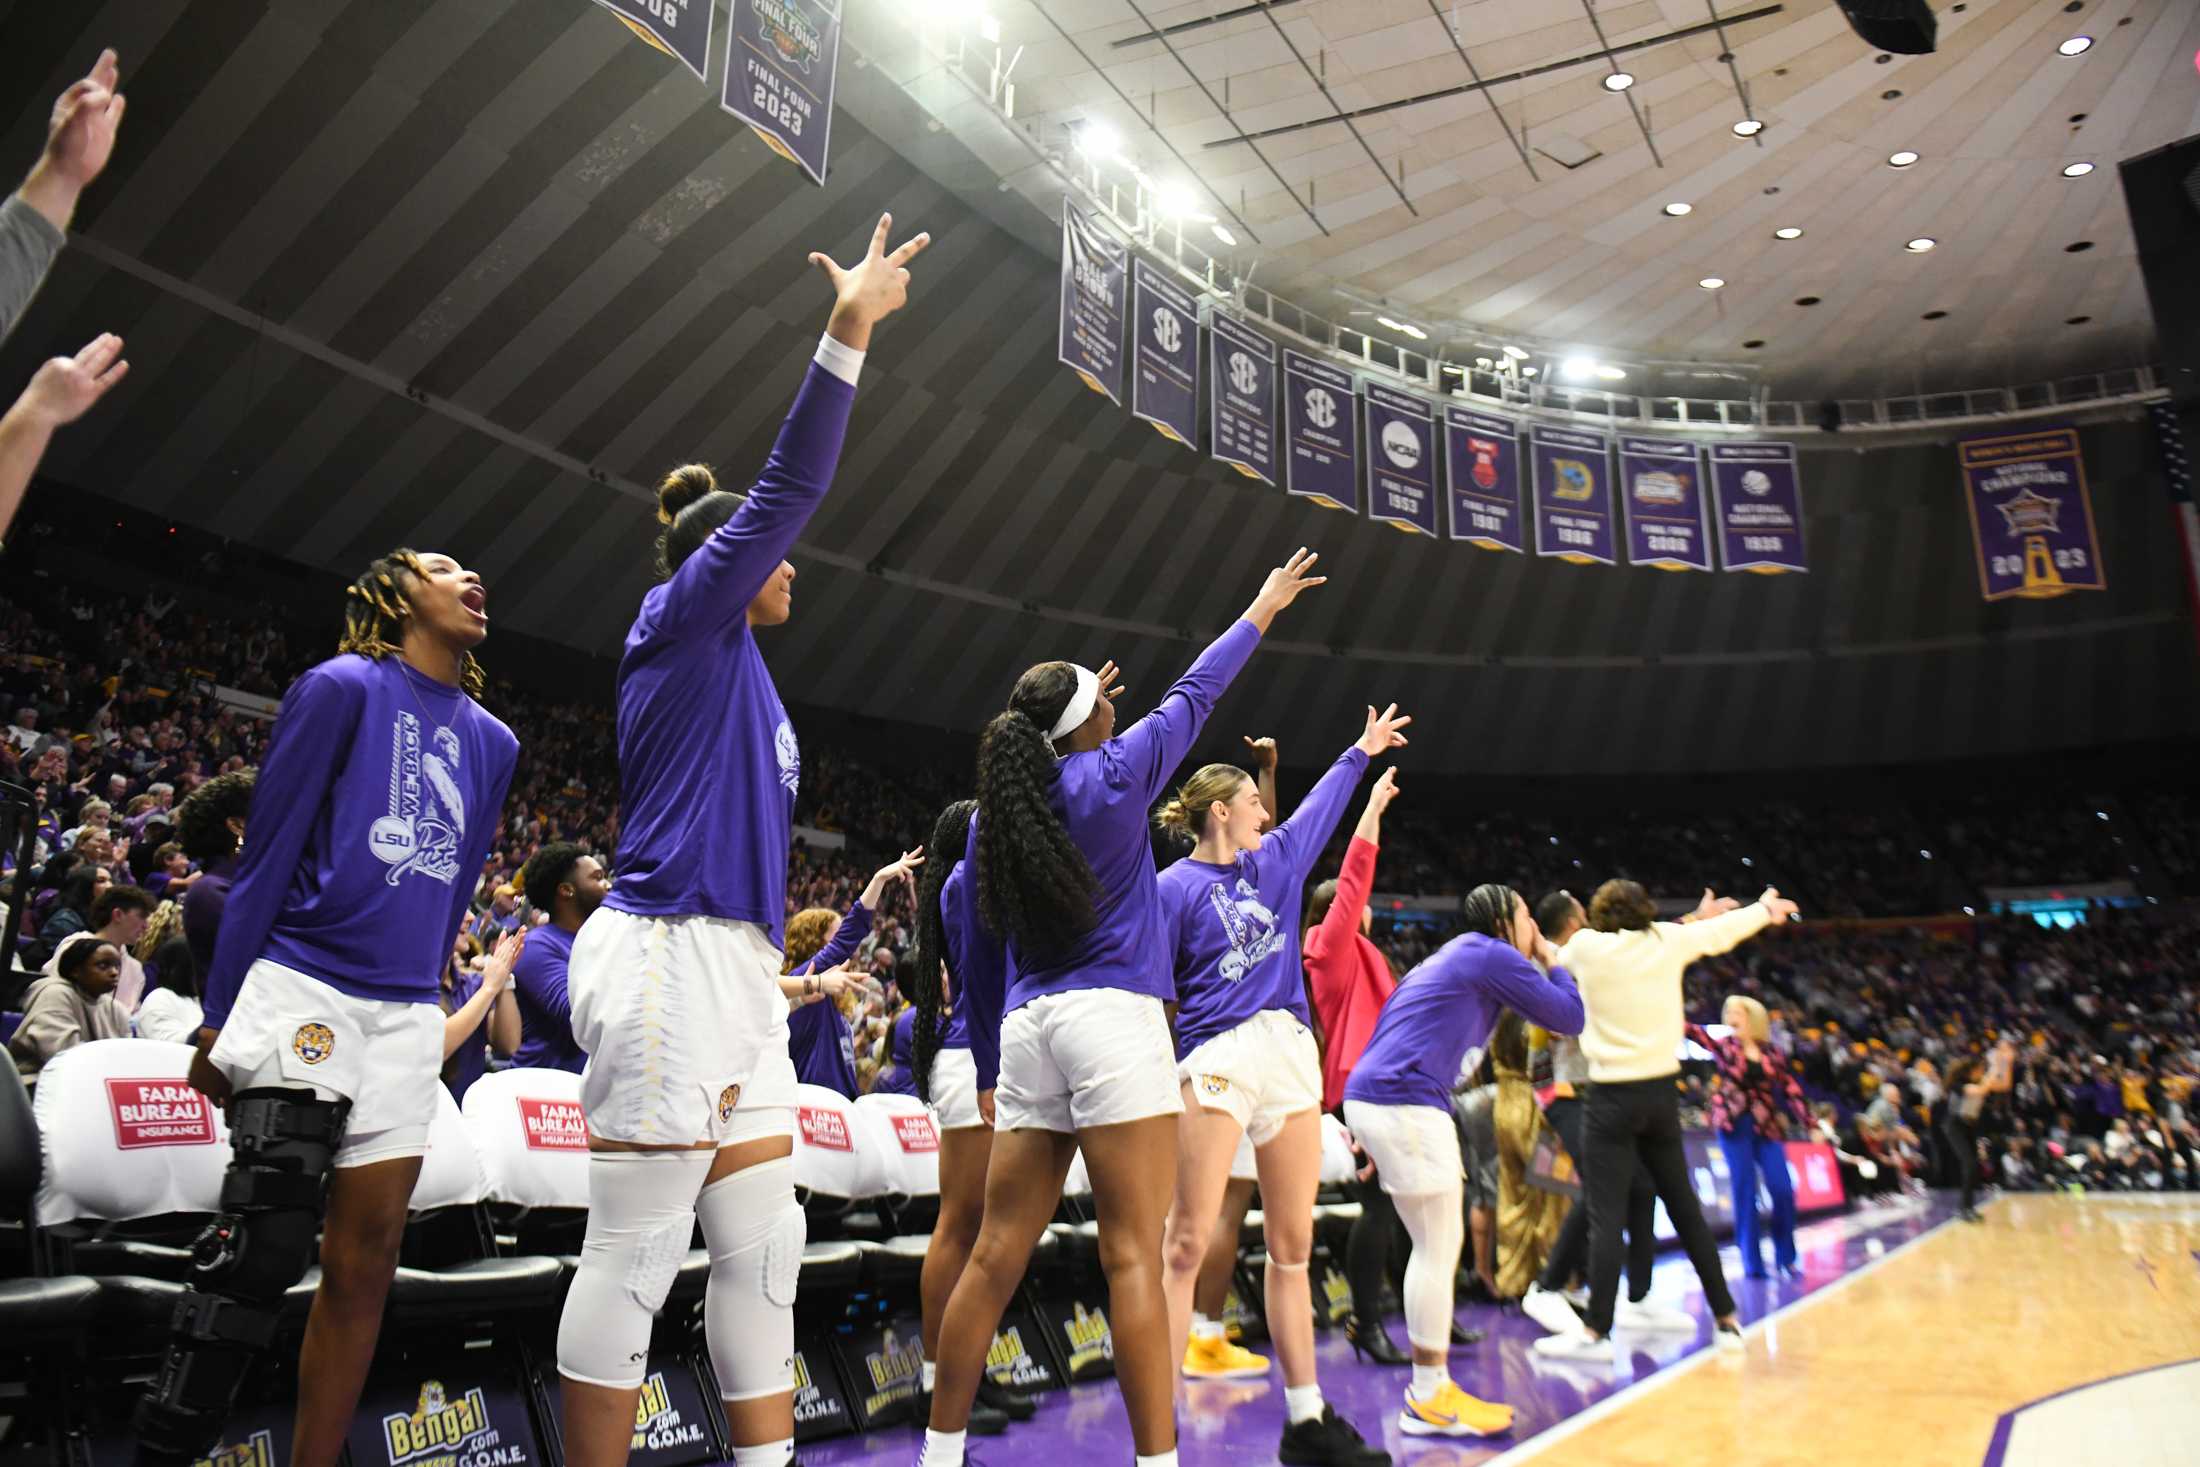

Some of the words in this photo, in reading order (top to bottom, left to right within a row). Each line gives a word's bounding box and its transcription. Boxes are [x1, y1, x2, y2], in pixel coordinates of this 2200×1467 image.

[789, 20, 819, 57] FOUR
[748, 59, 780, 94] FINAL
[784, 86, 811, 119] FOUR
[753, 84, 802, 136] 2023
[401, 782, 420, 817] WE
[374, 831, 410, 849] LSU
[138, 1086, 199, 1103] FARM
[120, 1103, 202, 1122] BUREAU
[540, 1103, 582, 1121] FARM
[811, 1109, 841, 1123] FARM
[137, 1125, 205, 1137] INSURANCE
[528, 1116, 585, 1134] BUREAU
[802, 1118, 845, 1136] BUREAU
[389, 1391, 486, 1458] Bengal
[467, 1429, 500, 1455] .com
[647, 1423, 705, 1450] G.O.N.E.
